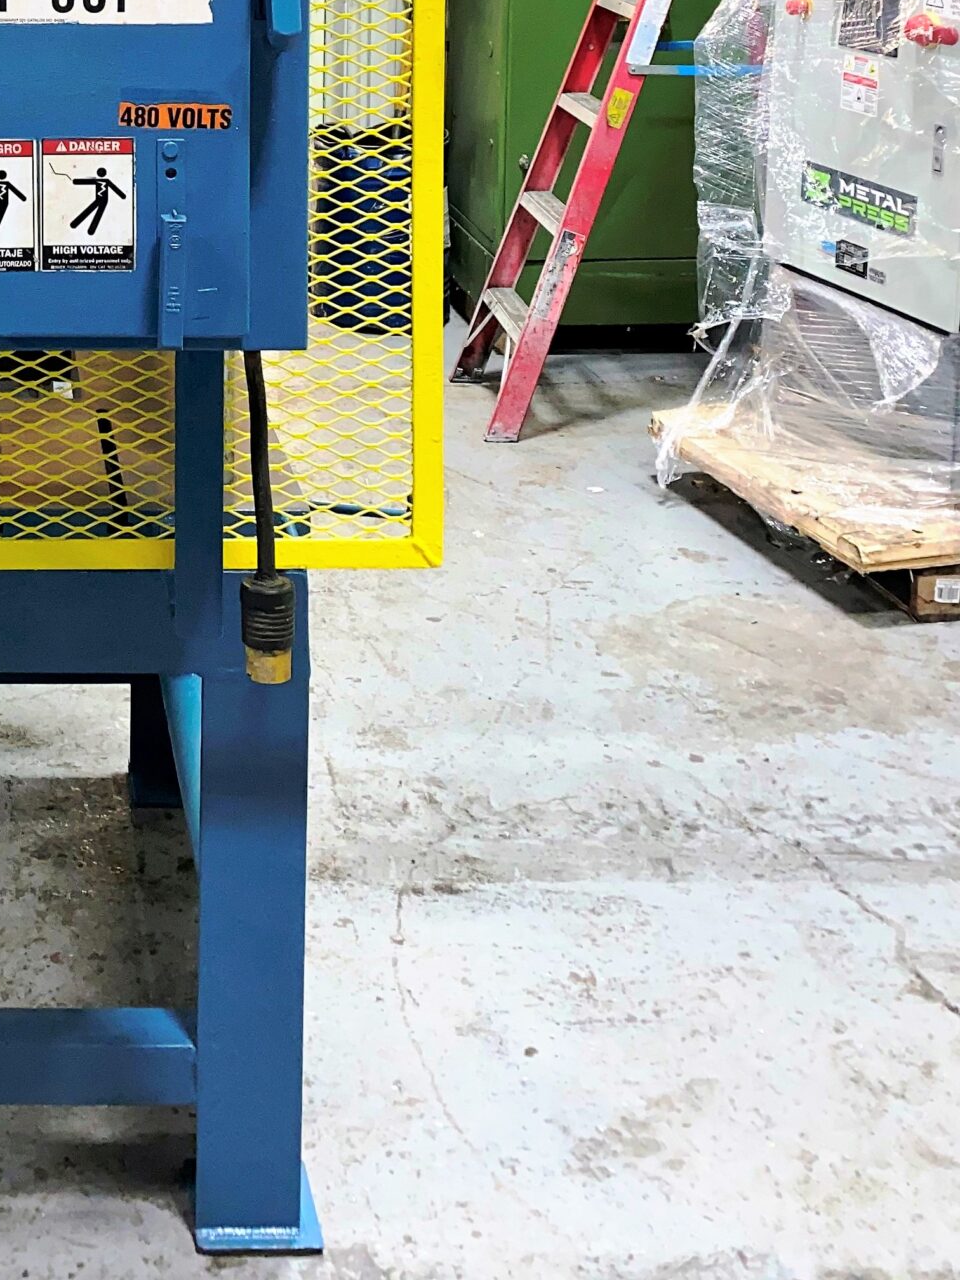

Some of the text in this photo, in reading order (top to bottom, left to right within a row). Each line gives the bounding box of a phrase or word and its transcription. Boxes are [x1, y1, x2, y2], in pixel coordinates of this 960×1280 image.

[120, 106, 232, 130] 480 VOLTS
[69, 141, 121, 152] DANGER
[839, 178, 909, 216] METAL
[838, 194, 910, 233] PRESS
[52, 246, 123, 255] HIGH VOLTAGE
